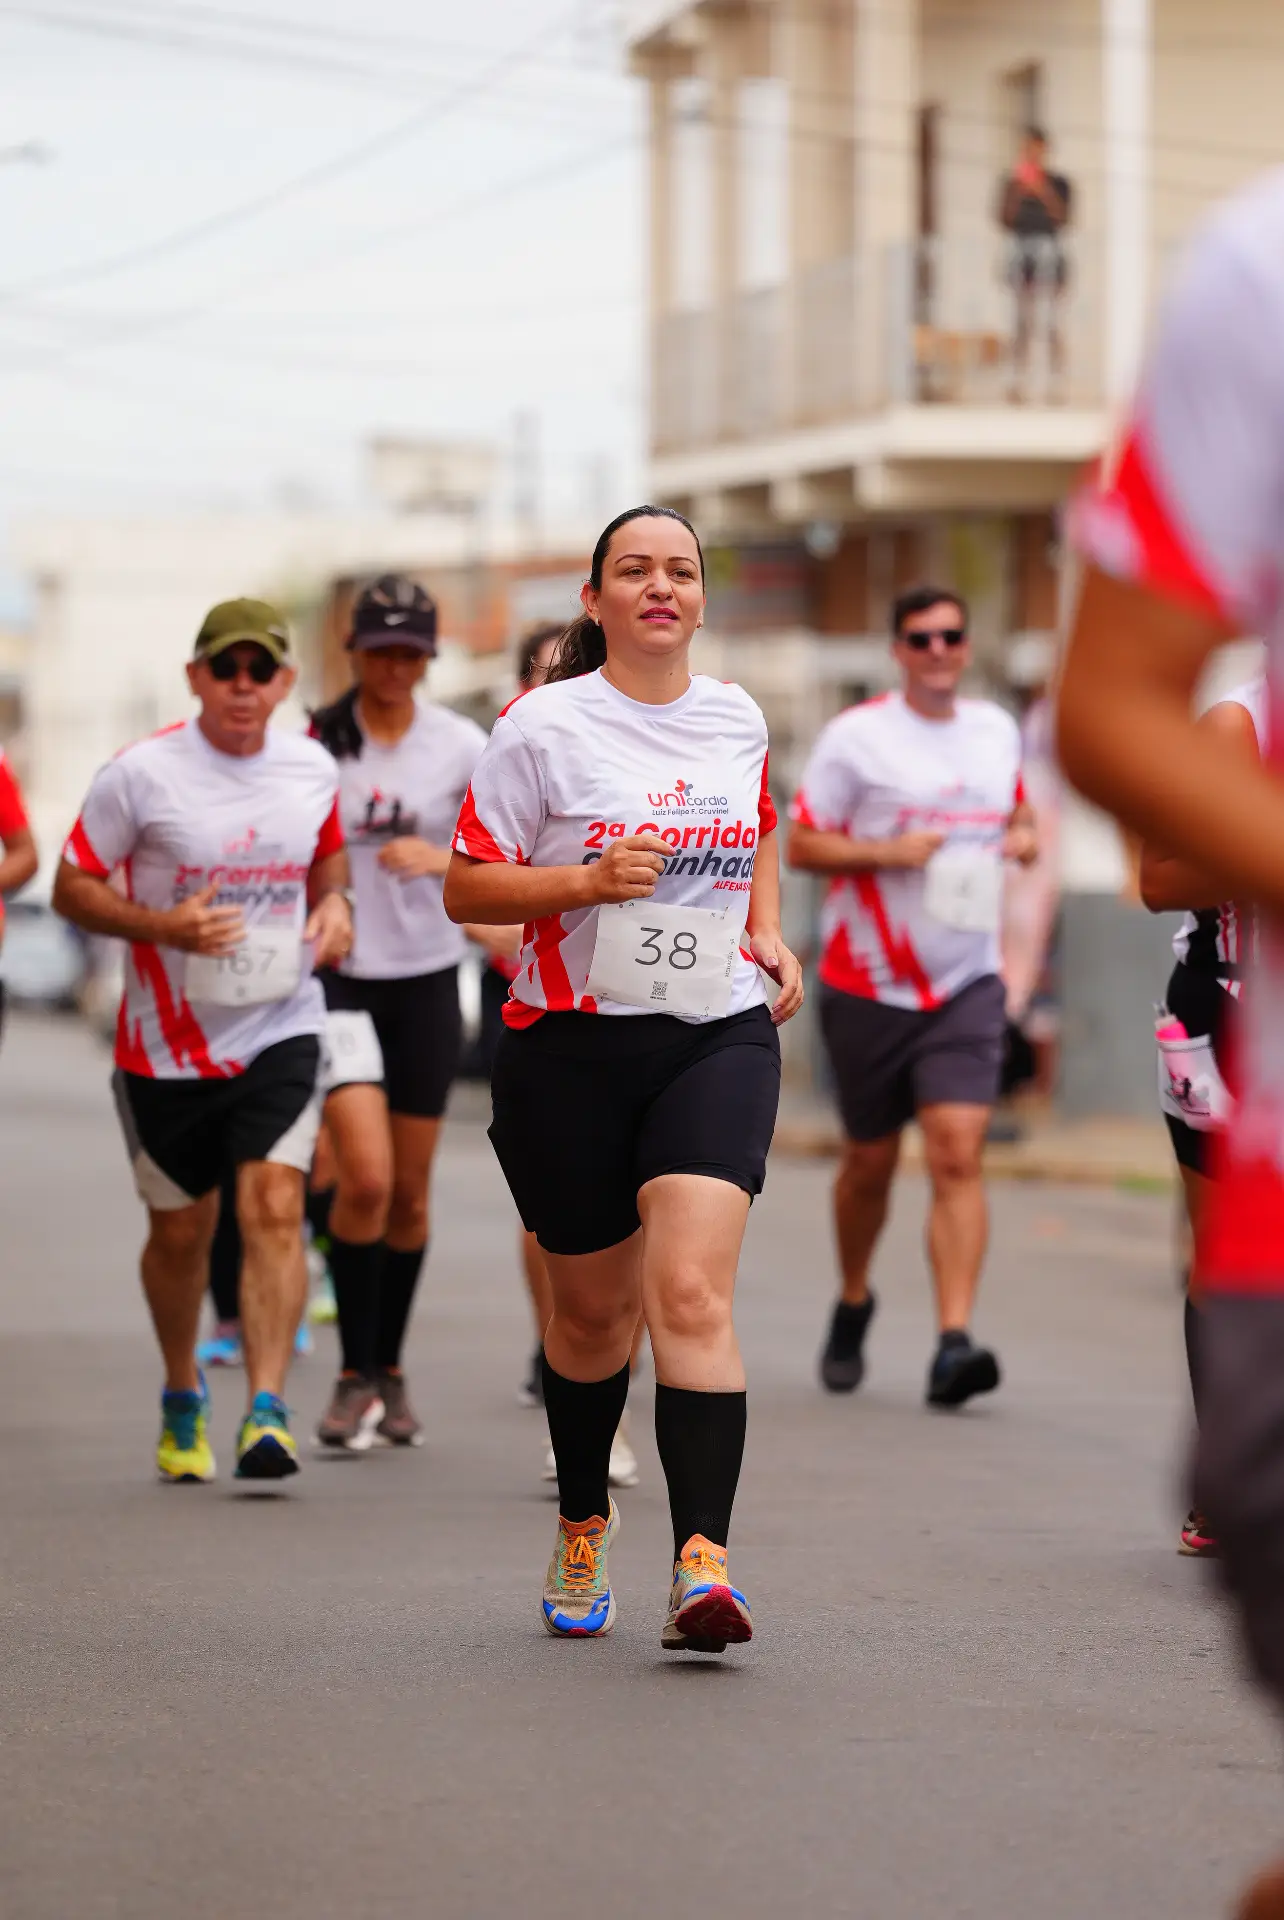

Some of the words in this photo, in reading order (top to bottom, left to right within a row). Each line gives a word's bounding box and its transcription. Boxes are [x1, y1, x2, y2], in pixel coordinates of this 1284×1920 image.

[667, 808, 690, 816] Felipe
[698, 807, 729, 815] Cruvinel
[581, 848, 755, 878] inhad
[215, 948, 280, 975] 167
[634, 926, 698, 970] 38
